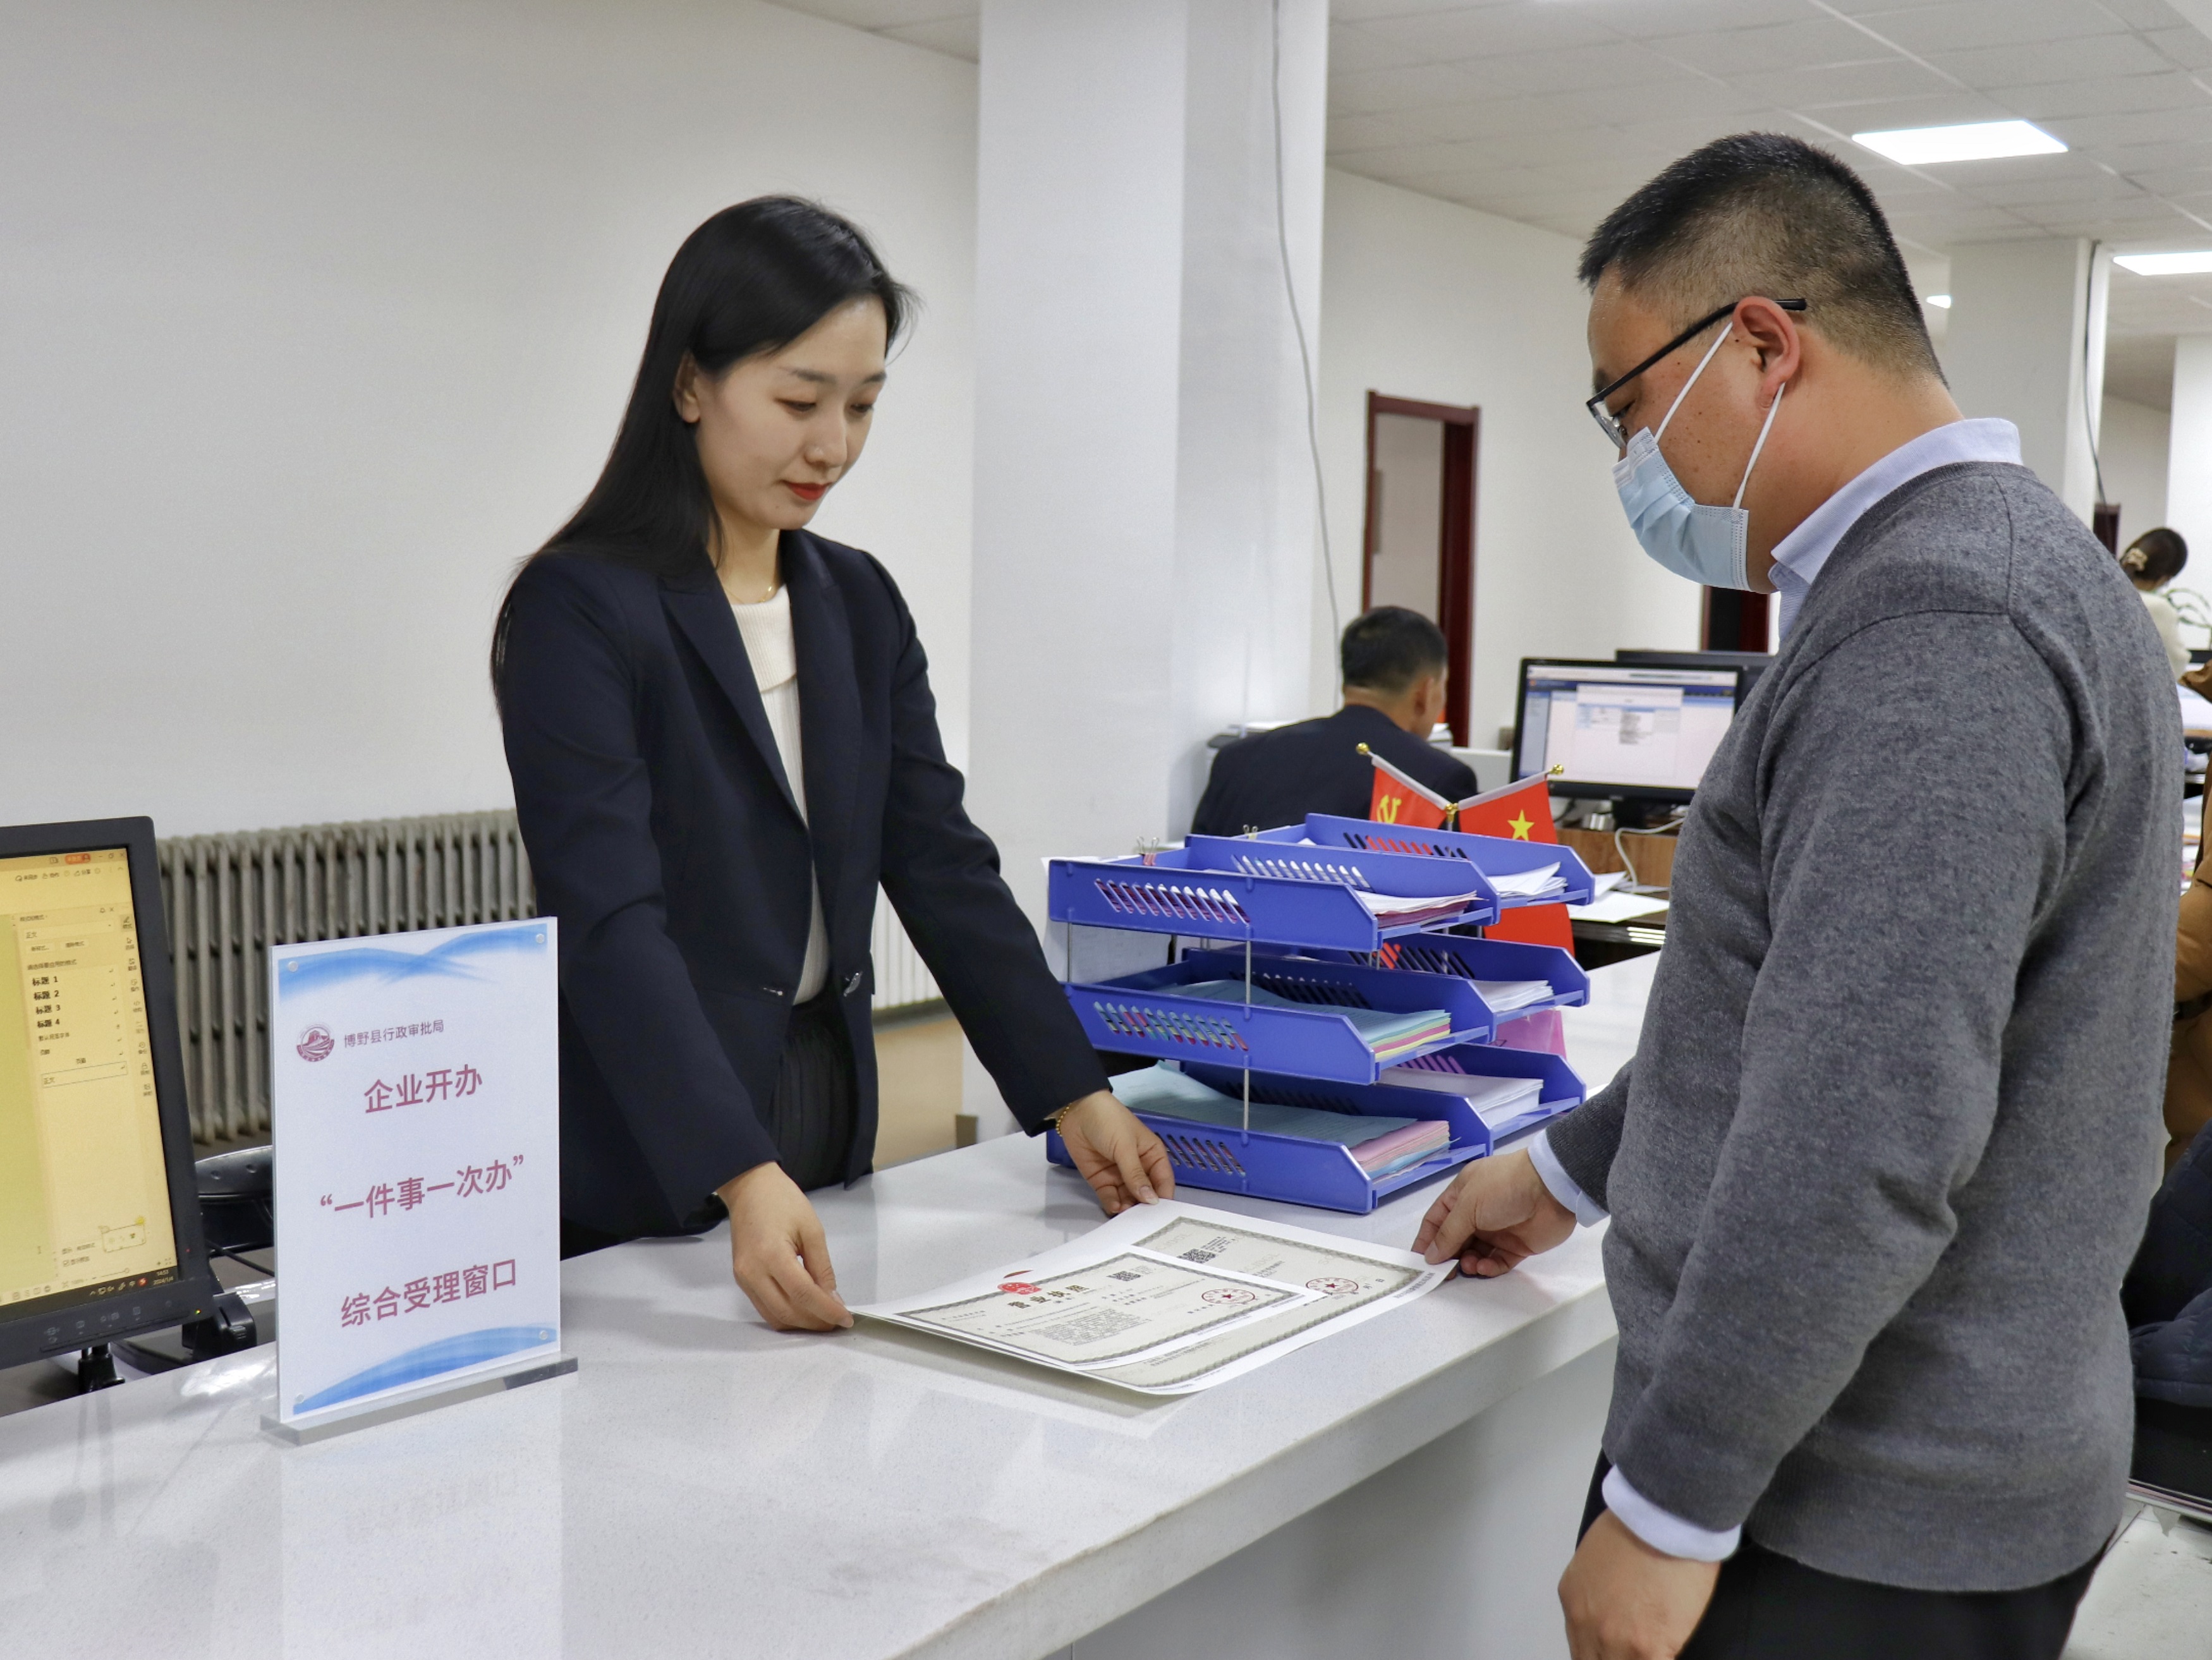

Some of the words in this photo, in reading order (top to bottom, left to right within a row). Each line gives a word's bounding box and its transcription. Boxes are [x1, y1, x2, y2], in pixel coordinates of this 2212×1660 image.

[32, 976, 49, 986] 标题
[33, 990, 51, 1000] 标题
[35, 1005, 52, 1015] 标题
[37, 1019, 52, 1029] 标题
[344, 1020, 444, 1047] 博野县行政审批局
[364, 1064, 482, 1113] 企业开办
[320, 1154, 523, 1218] “一件事一次办”
[341, 1259, 515, 1327] 综合受理窗口
